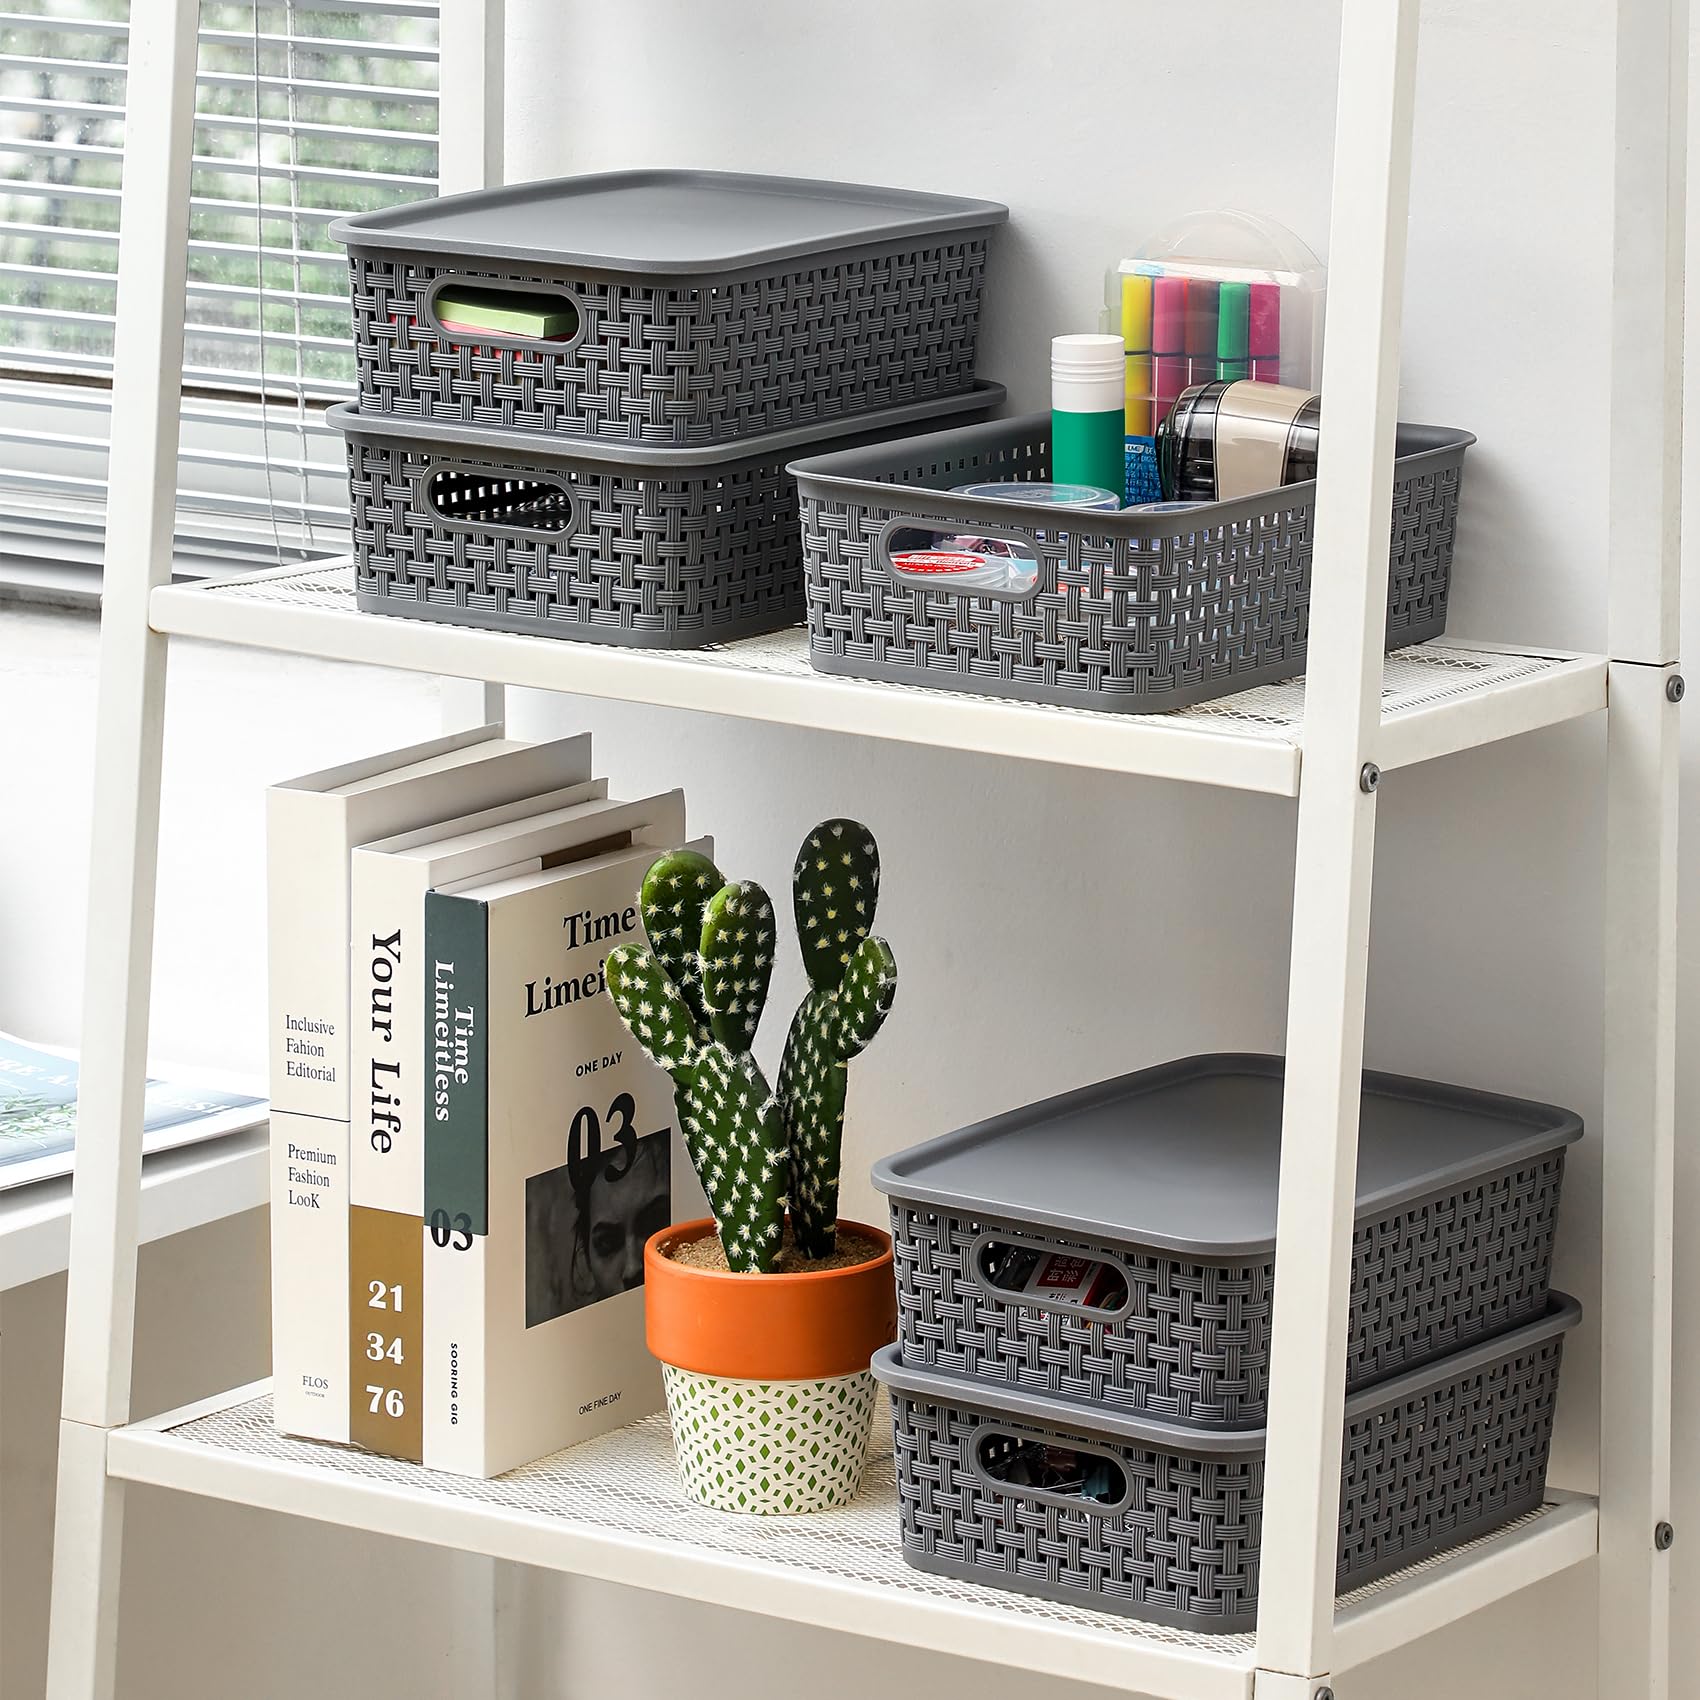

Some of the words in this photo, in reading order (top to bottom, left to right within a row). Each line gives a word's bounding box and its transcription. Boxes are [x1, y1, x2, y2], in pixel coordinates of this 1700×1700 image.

[563, 906, 636, 950] Time
[371, 929, 401, 1043] Your
[525, 959, 607, 1017] Limei
[286, 1014, 335, 1036] Inclusive
[434, 960, 455, 1122] Limeitless
[286, 1037, 325, 1057] Fahion
[454, 1006, 474, 1085] Time
[286, 1060, 336, 1082] Editorial
[575, 1059, 598, 1077] ONE
[602, 1051, 622, 1069] DAY
[371, 1058, 402, 1154] Life
[288, 1143, 337, 1165] Premium
[567, 1092, 638, 1201] 03
[288, 1166, 330, 1187] Fashion
[288, 1189, 320, 1209] LooK
[430, 1208, 474, 1251] 03
[368, 1280, 403, 1312] 21
[366, 1332, 404, 1365] 34
[302, 1375, 329, 1390] FLOS
[450, 1342, 459, 1398] SOORING
[365, 1385, 405, 1418] 76
[450, 1403, 459, 1425] GIG
[578, 1402, 593, 1415] ONE
[593, 1396, 608, 1409] FINE
[609, 1391, 622, 1404] DAY
